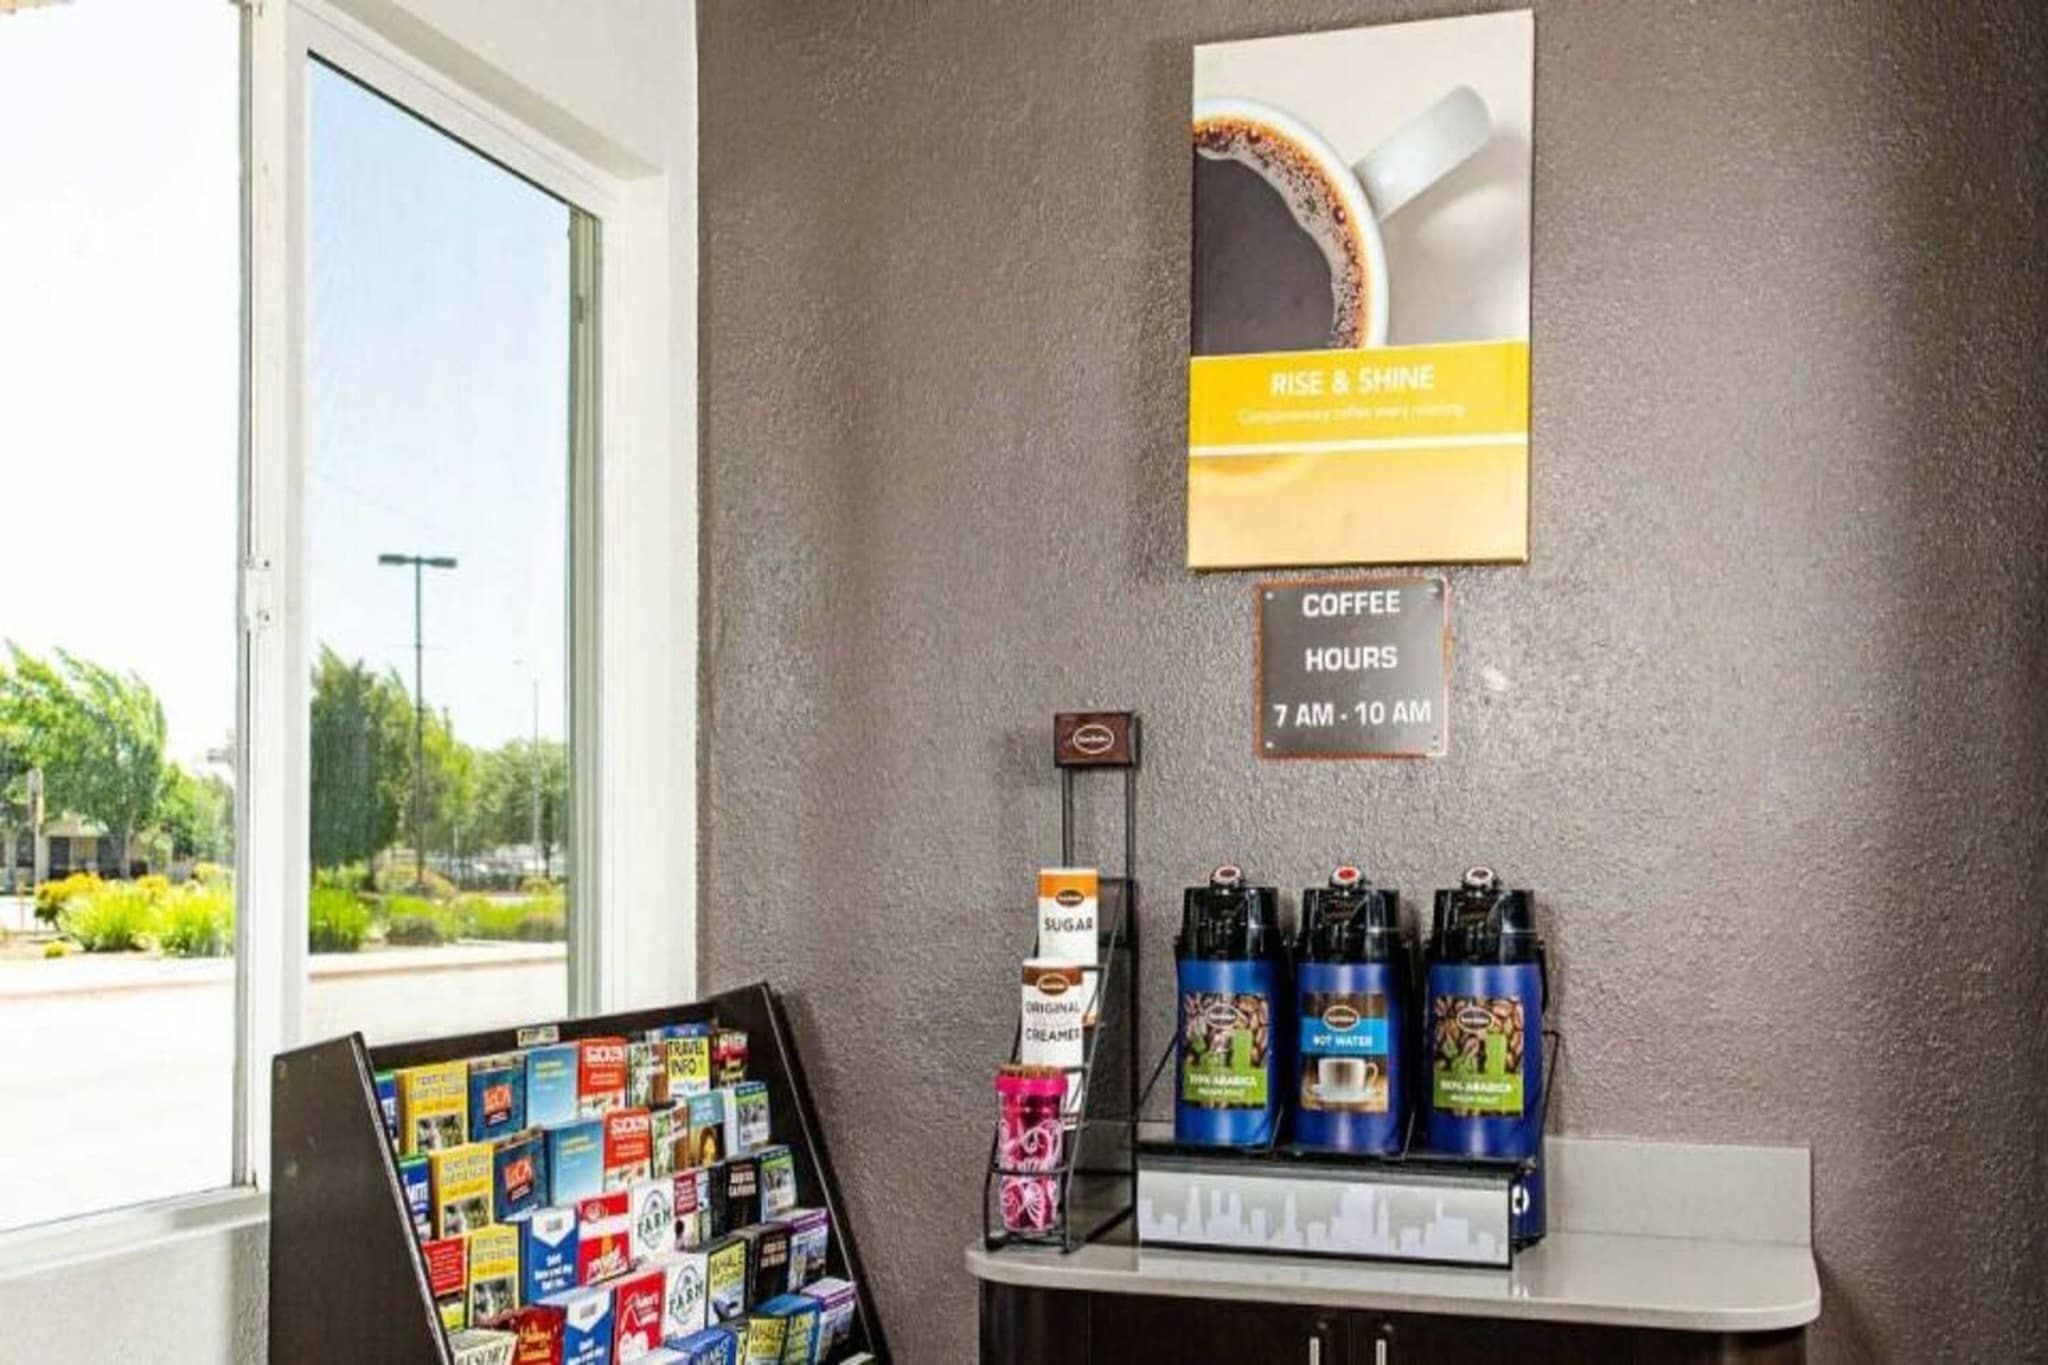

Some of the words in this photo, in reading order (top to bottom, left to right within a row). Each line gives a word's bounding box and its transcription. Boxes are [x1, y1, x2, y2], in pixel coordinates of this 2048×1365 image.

[1270, 371, 1323, 397] RISE
[1332, 369, 1350, 394] &
[1359, 364, 1436, 391] SHINE
[1302, 590, 1401, 617] COFFEE
[1305, 646, 1398, 672] HOURS
[1273, 704, 1288, 728] 7
[1295, 703, 1334, 727] AM
[1354, 701, 1385, 725] 10
[1392, 700, 1432, 725] AM
[1044, 916, 1094, 933] SUGAR
[1025, 999, 1081, 1016] ORIGINAL
[1025, 1027, 1081, 1043] CREAMER
[1335, 1034, 1374, 1048] WATER
[667, 1039, 705, 1058] TRAVEL
[637, 1206, 672, 1238] FARM
[669, 1278, 704, 1311] FARM
